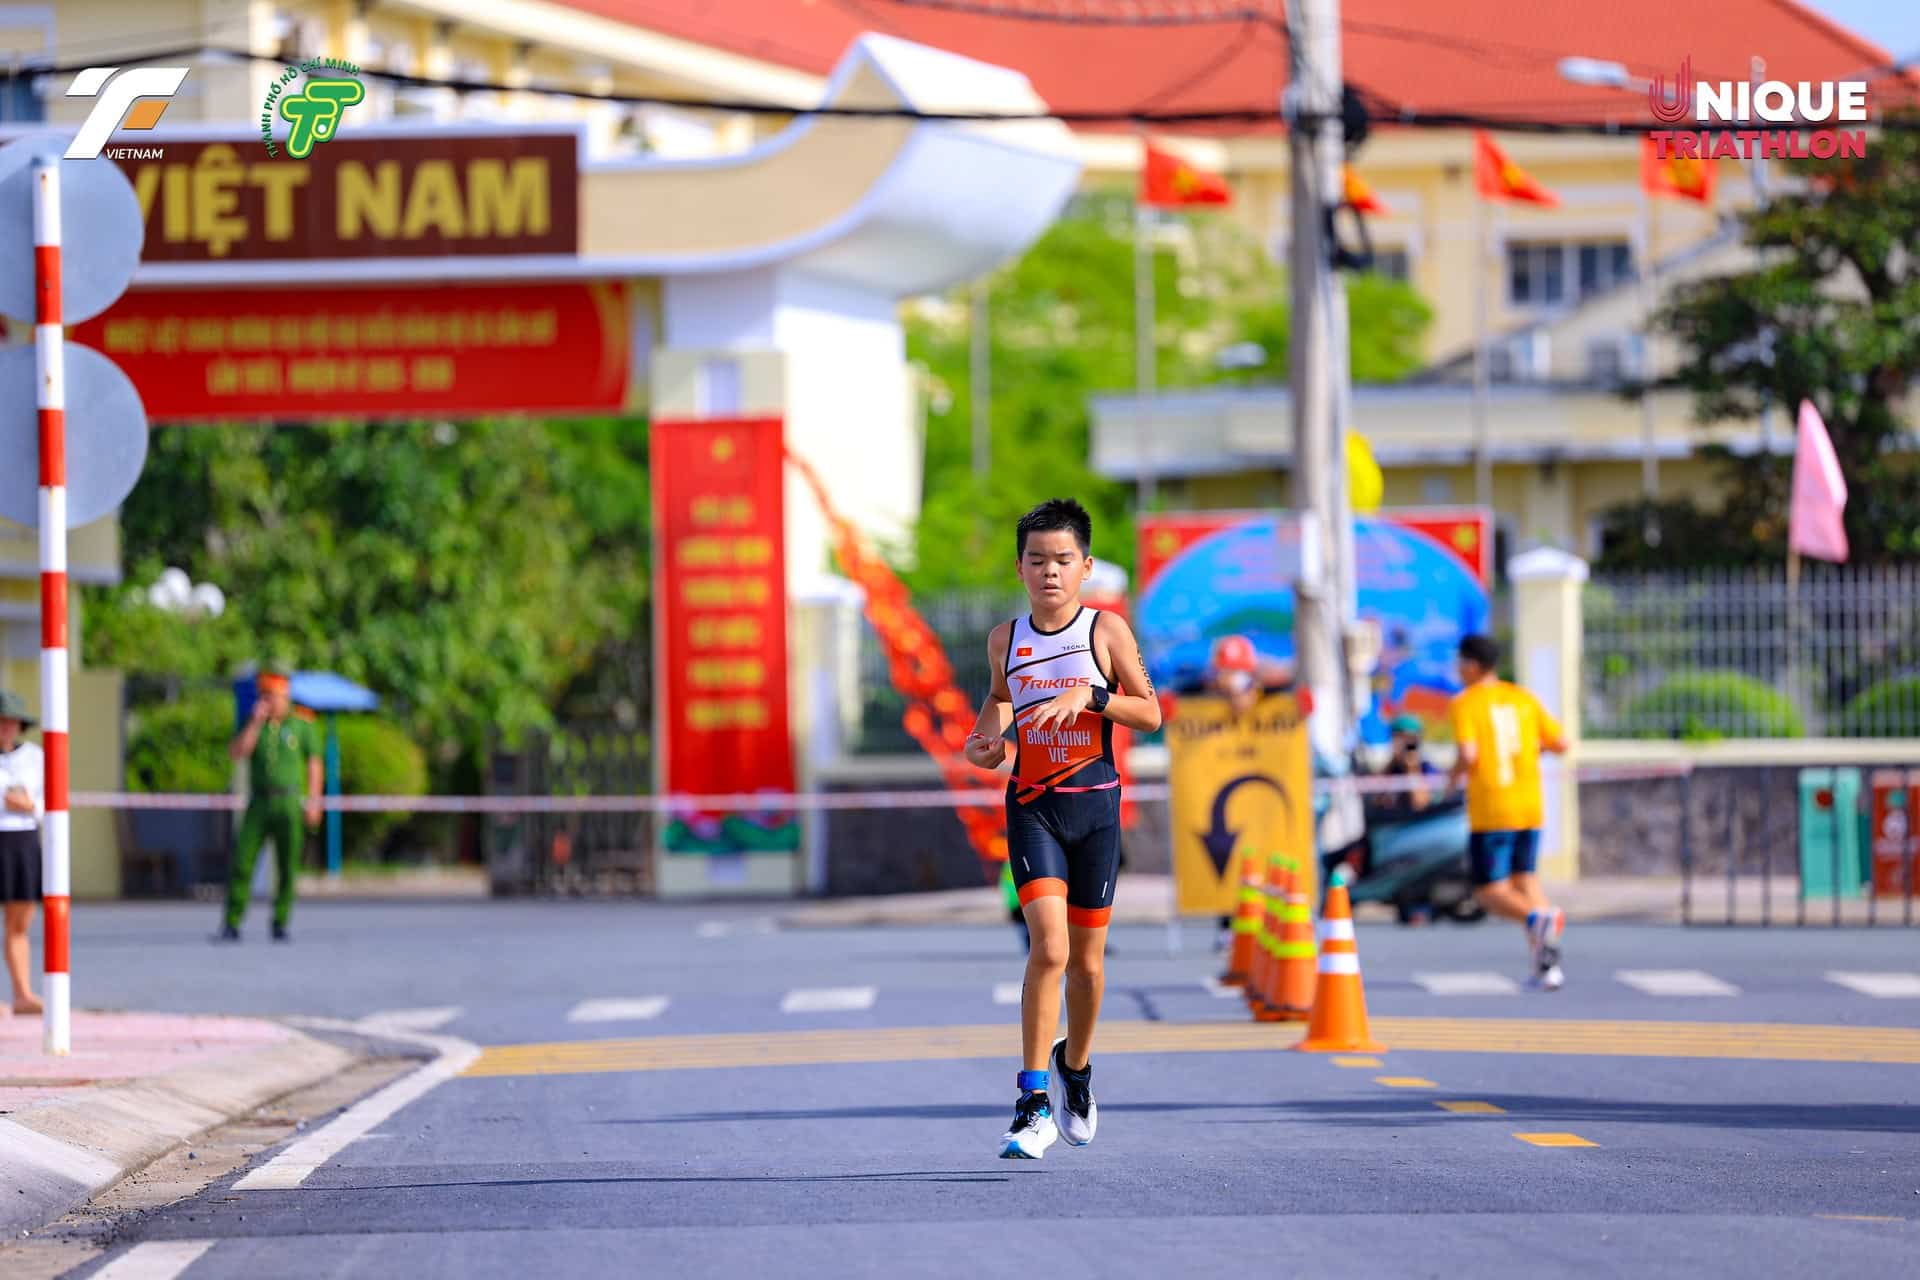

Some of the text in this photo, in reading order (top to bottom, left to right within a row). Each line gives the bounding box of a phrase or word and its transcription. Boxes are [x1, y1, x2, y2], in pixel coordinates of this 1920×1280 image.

[335, 156, 551, 241] NAM
[1012, 674, 1090, 695] TRIKIDS
[1057, 729, 1091, 746] MINH
[1048, 747, 1069, 763] VIE
